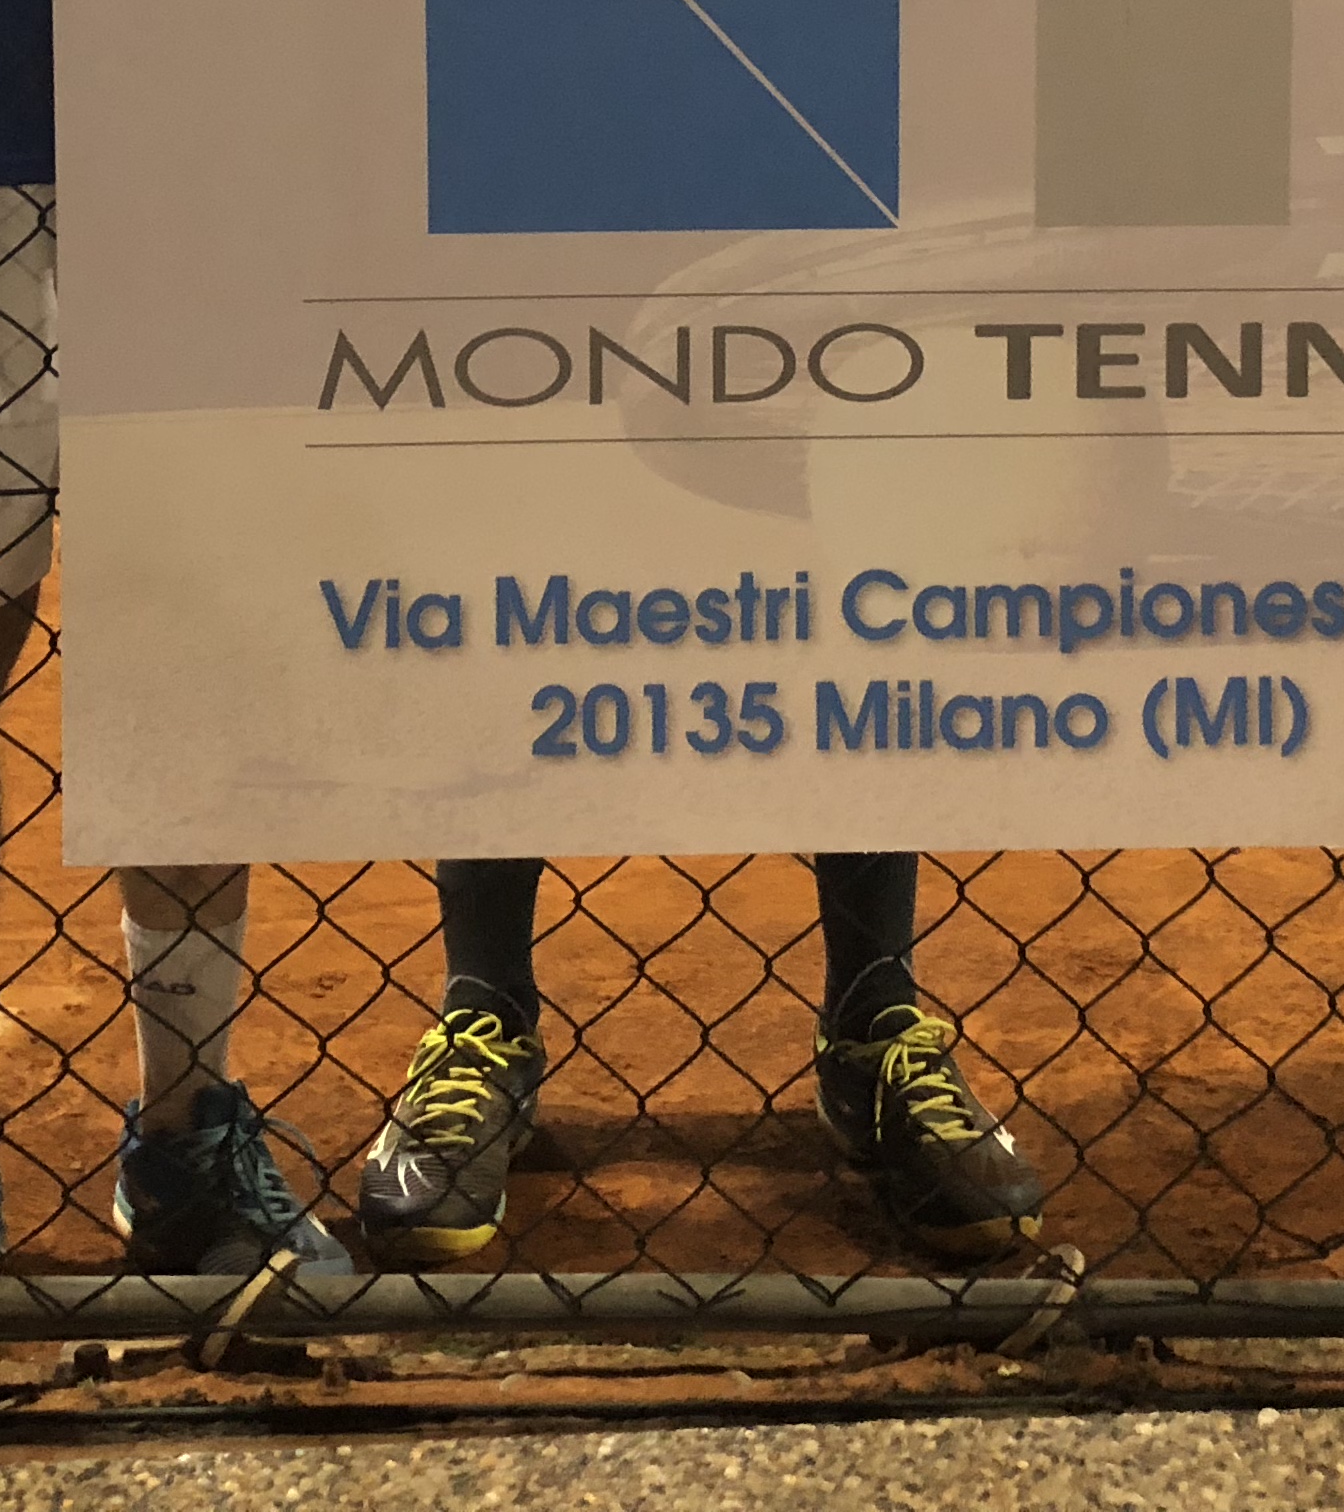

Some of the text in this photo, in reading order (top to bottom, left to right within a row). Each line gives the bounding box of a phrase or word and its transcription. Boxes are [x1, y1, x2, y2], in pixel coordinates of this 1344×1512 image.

[317, 321, 925, 411] MONDO
[319, 578, 461, 650] Via
[493, 571, 812, 648] Maestri
[529, 675, 1311, 759] 20135 Milano (MI)
